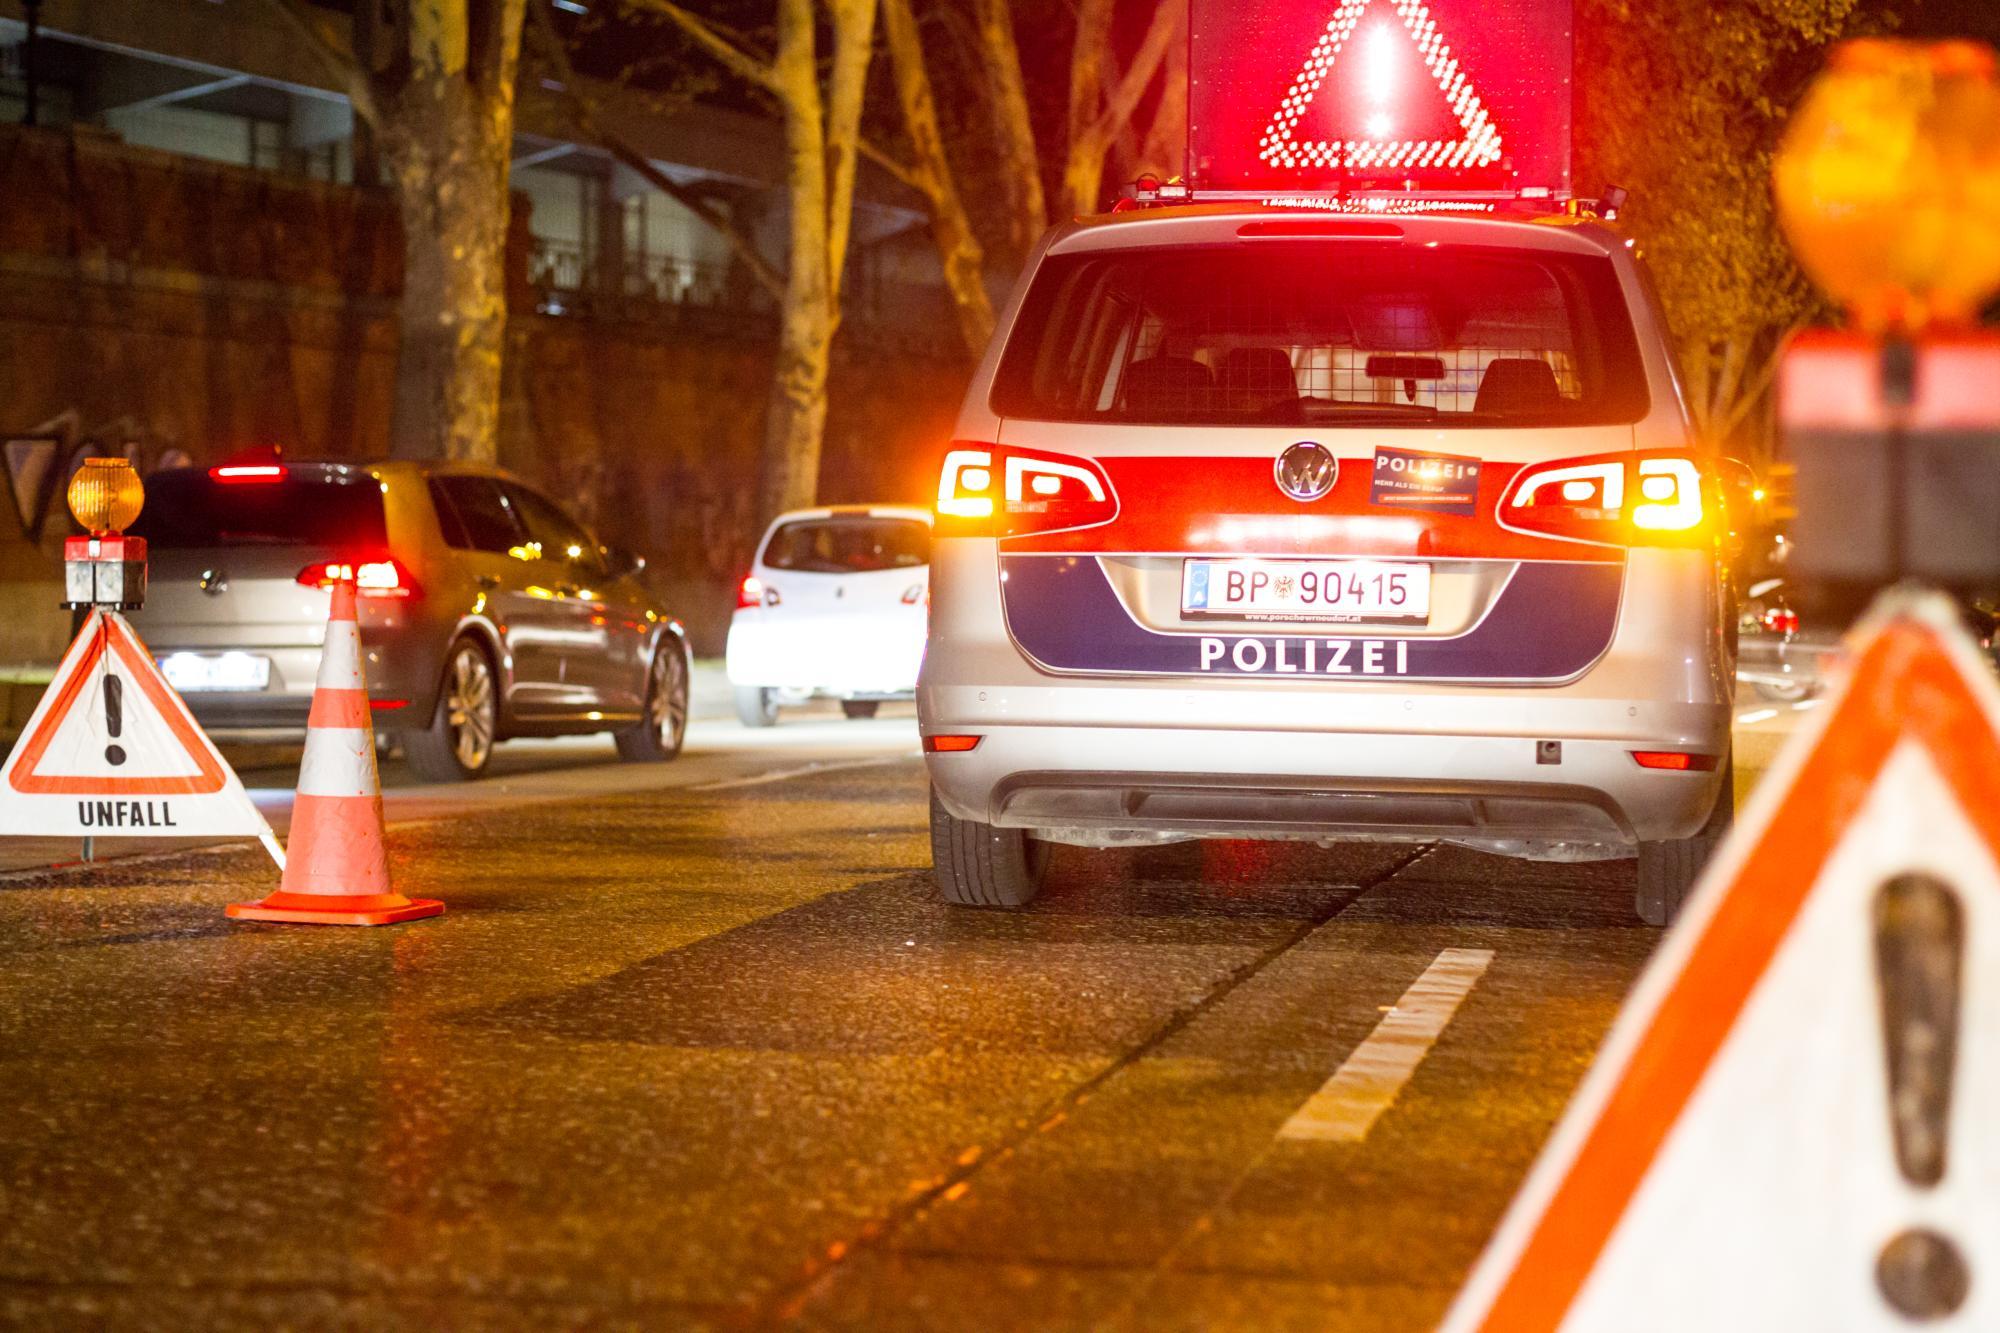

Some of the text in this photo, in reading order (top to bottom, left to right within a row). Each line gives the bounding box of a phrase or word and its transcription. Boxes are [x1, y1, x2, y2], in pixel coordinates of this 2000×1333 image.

[1376, 456, 1464, 479] POLIZEI
[1395, 481, 1408, 489] ALS
[1227, 571, 1269, 602] BP
[1300, 571, 1407, 605] 90415
[1200, 638, 1407, 674] POLIZEI
[78, 801, 177, 826] UNFALL
